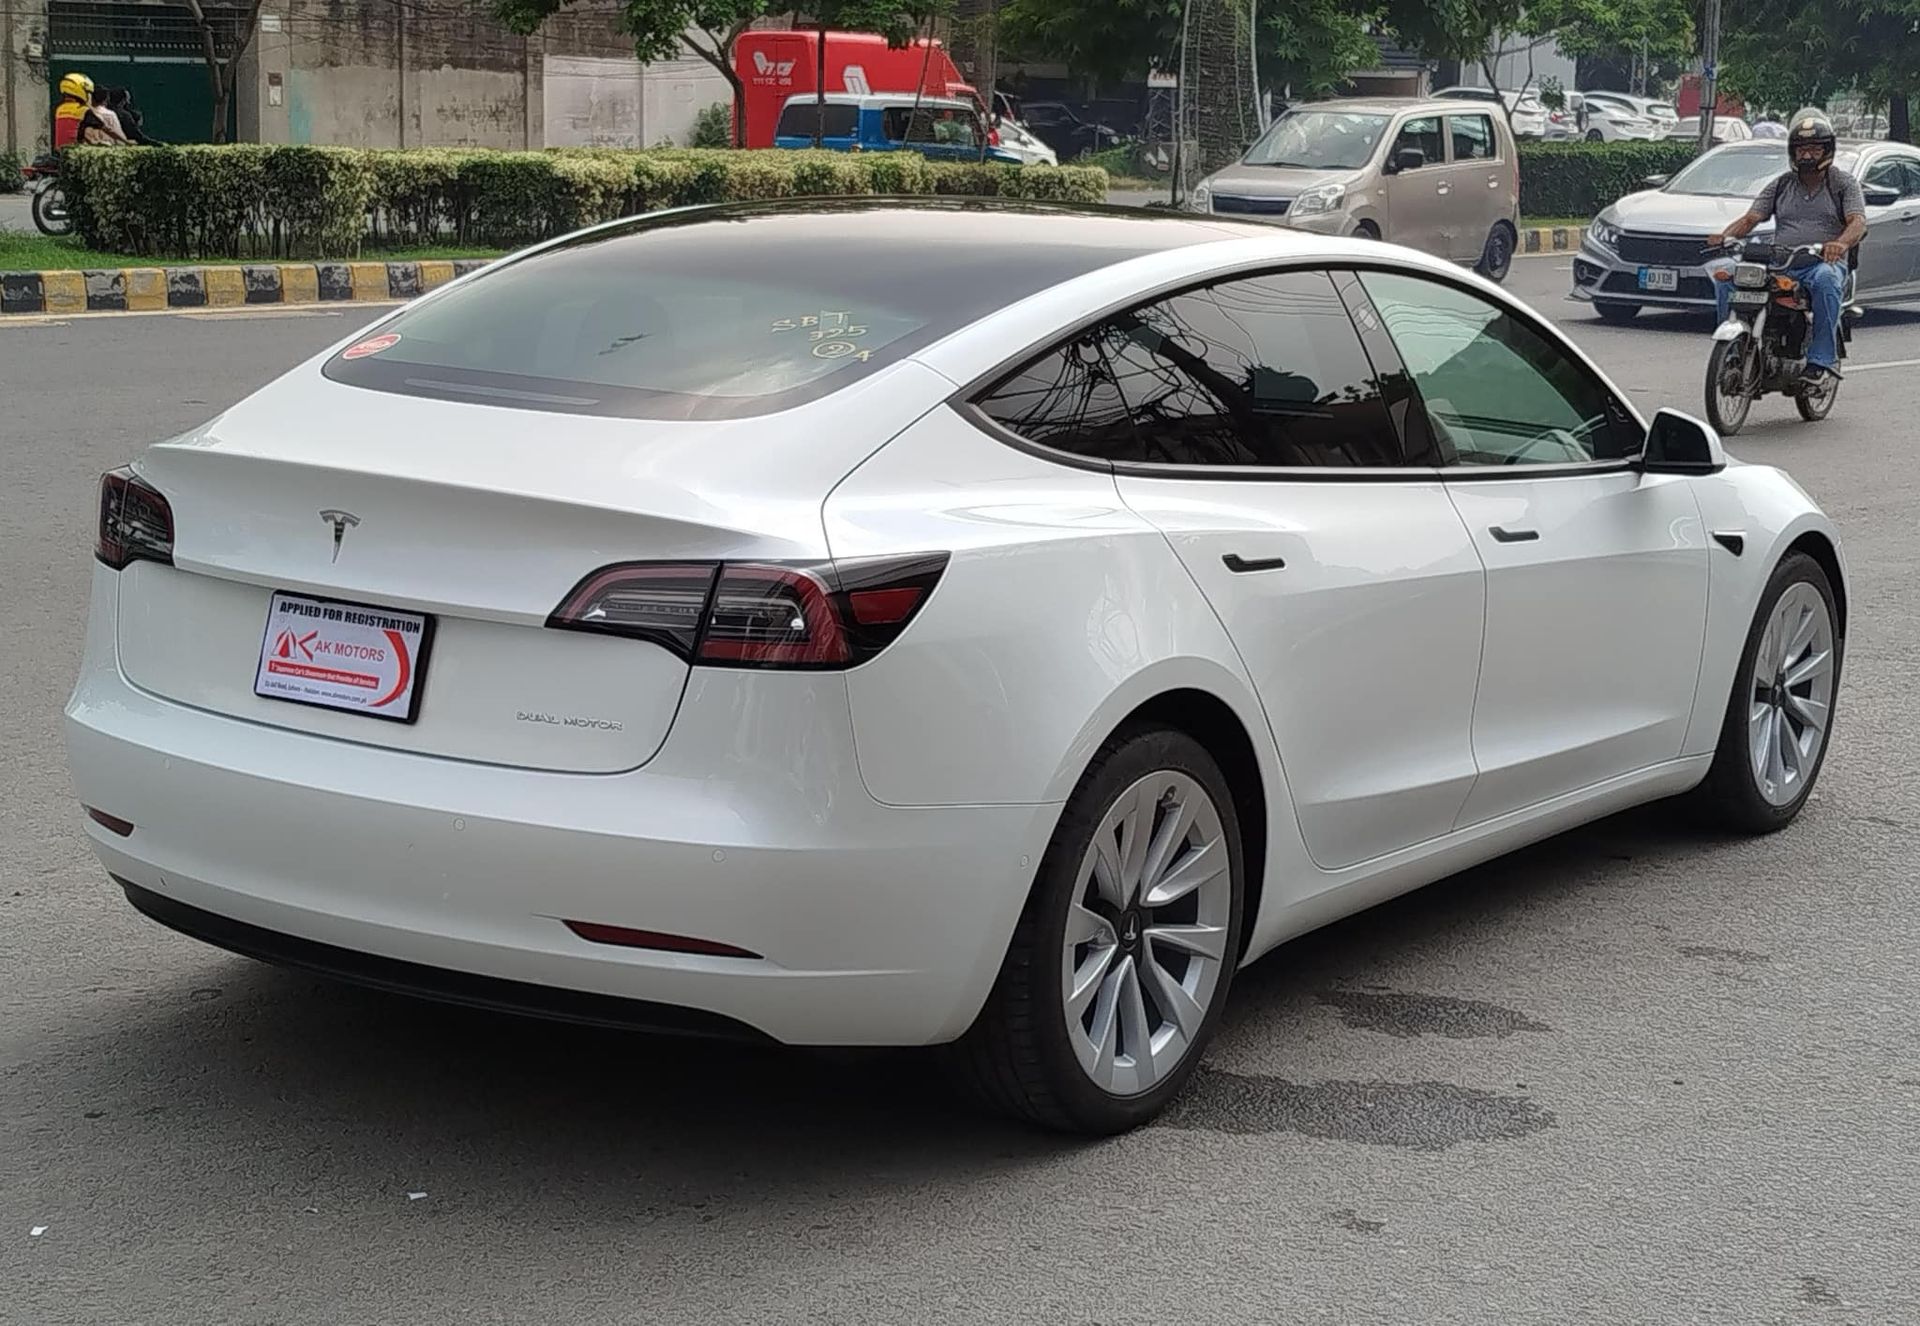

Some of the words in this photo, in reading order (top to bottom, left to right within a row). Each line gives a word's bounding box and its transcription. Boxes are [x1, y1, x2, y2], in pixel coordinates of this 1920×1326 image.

[808, 324, 870, 342] 325
[280, 602, 322, 618] APPLIED
[322, 608, 343, 622] FOR
[344, 611, 421, 634] REGISTRATION
[314, 640, 332, 654] AK
[335, 643, 385, 662] MOTORS
[516, 710, 560, 725] DUAL
[564, 716, 623, 731] MOTOR
